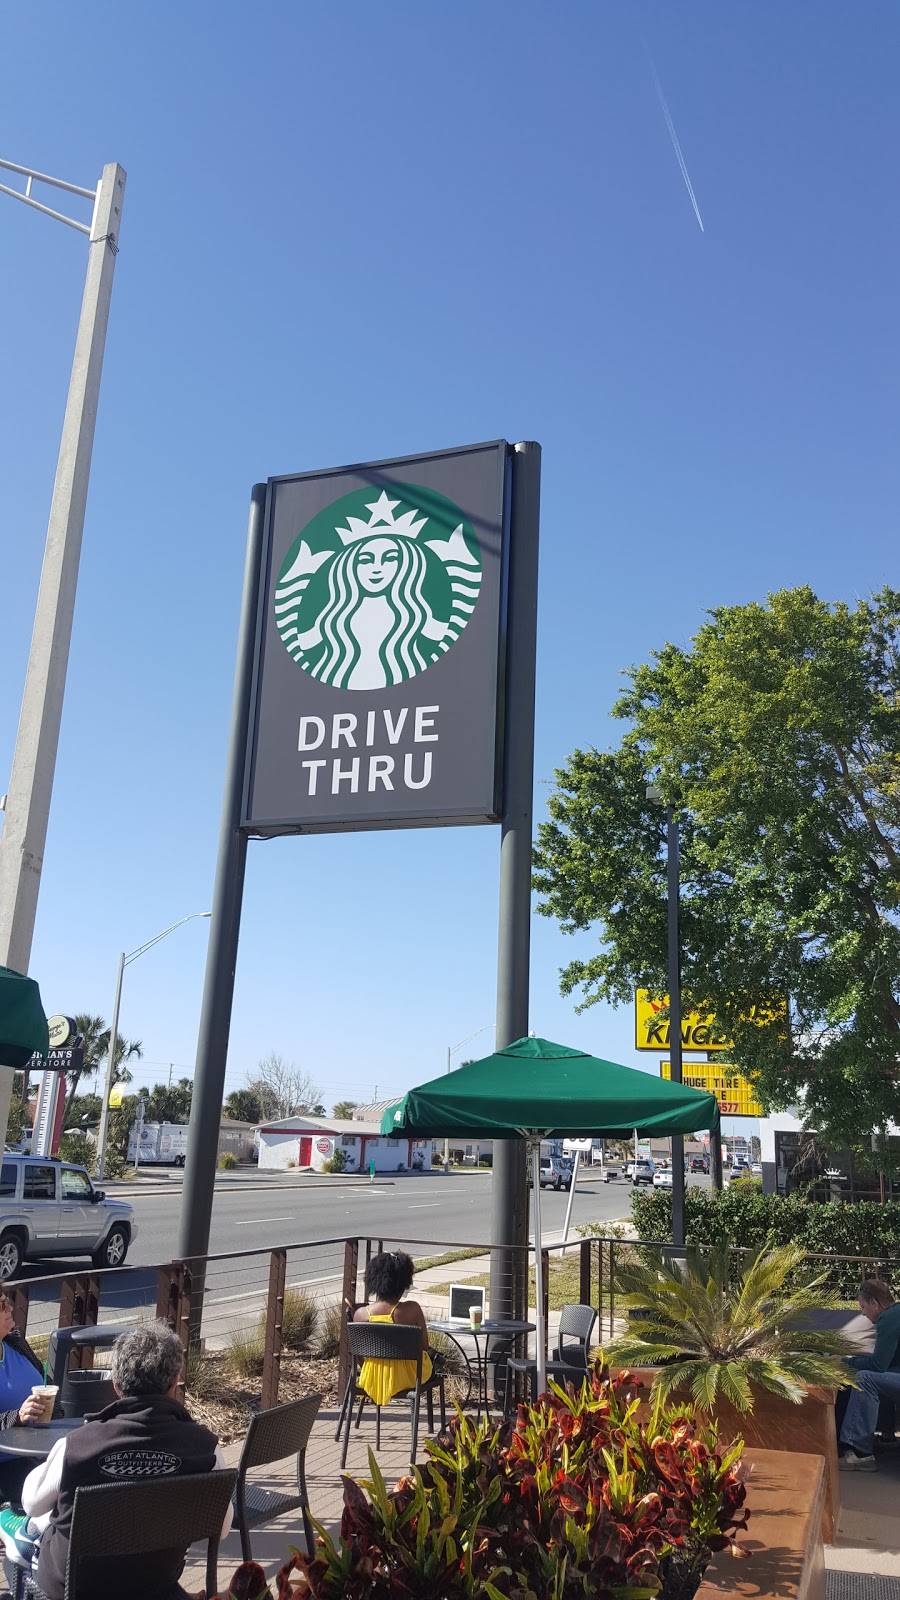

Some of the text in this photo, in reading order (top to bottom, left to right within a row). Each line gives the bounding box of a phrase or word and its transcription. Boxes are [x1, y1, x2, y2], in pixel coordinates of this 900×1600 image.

[297, 705, 440, 752] DRIVE
[301, 751, 433, 796] THRU
[683, 1077, 739, 1088] HUGE TIRE
[104, 1452, 177, 1464] GREAT ATLANTIC
